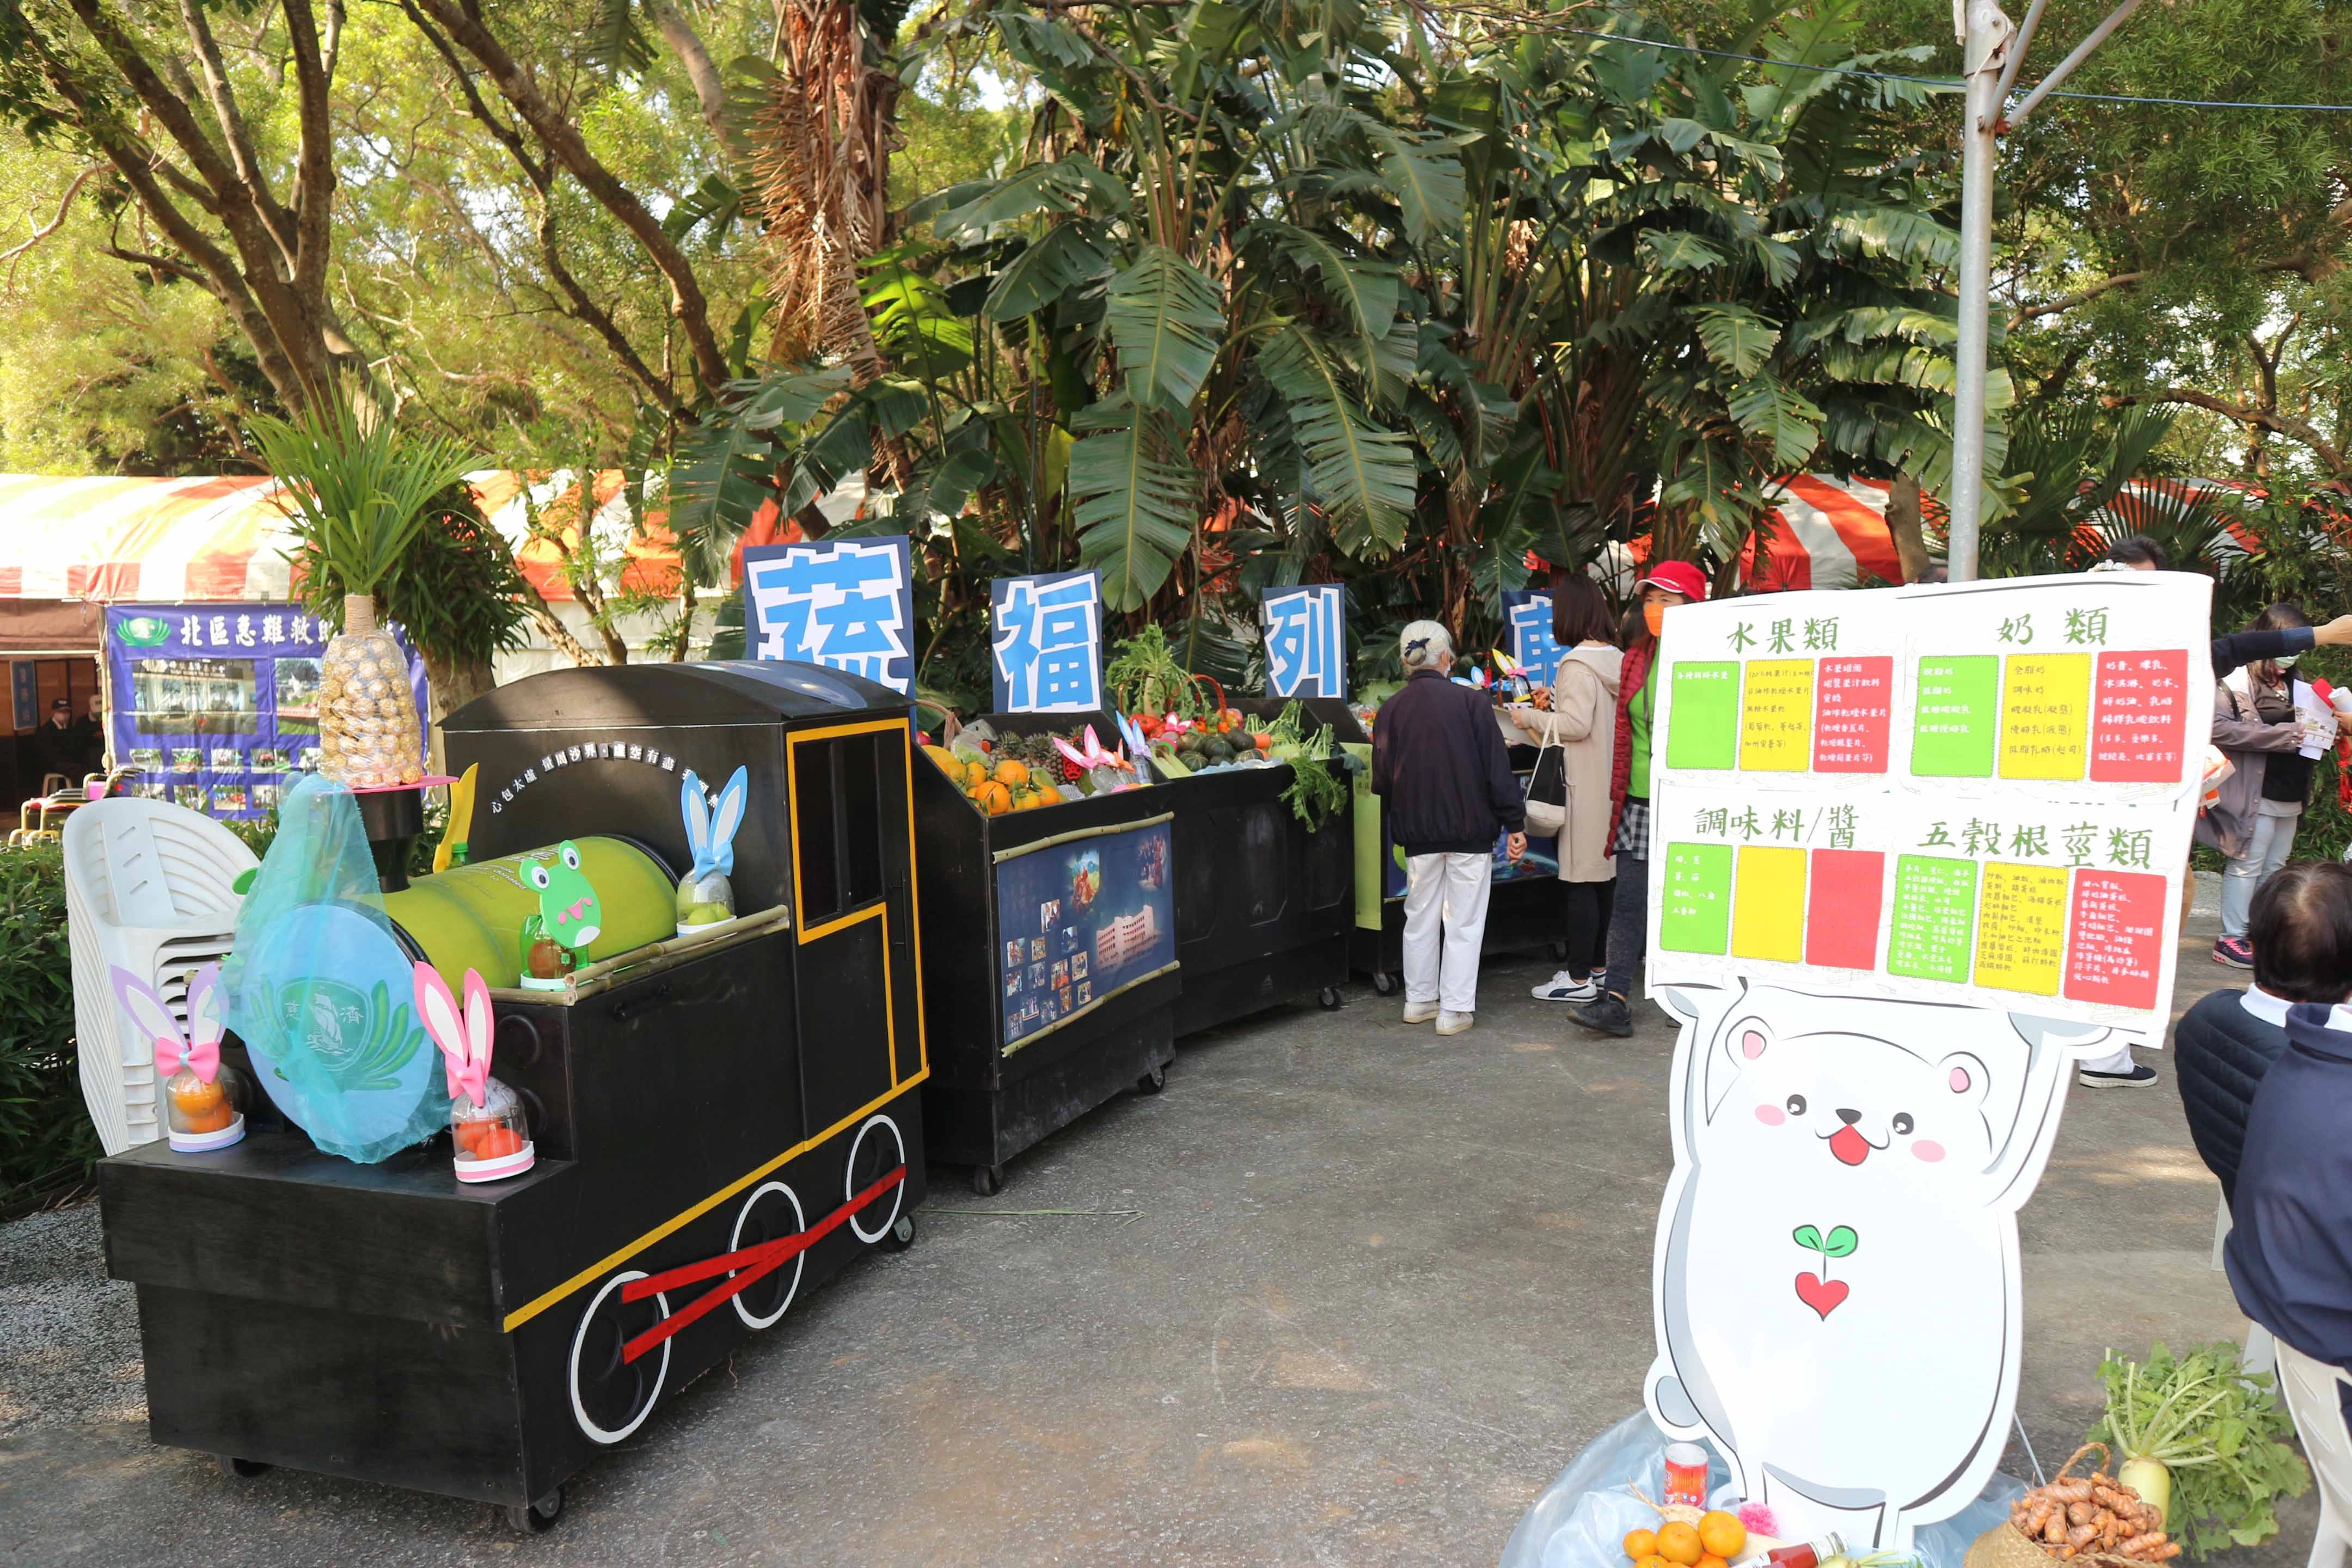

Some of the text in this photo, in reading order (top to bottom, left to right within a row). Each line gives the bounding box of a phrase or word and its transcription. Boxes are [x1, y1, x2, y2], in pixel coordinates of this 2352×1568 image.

[993, 573, 1102, 713] 福
[1264, 587, 1342, 698] 列
[1727, 616, 1839, 654] 水果類
[2012, 684, 2044, 695] 調味奶
[2013, 665, 2045, 675] 全脂奶
[1694, 804, 1860, 849] 調味料/醬
[1918, 817, 2154, 871] 五穀根莖類
[340, 1006, 364, 1024] 濟
